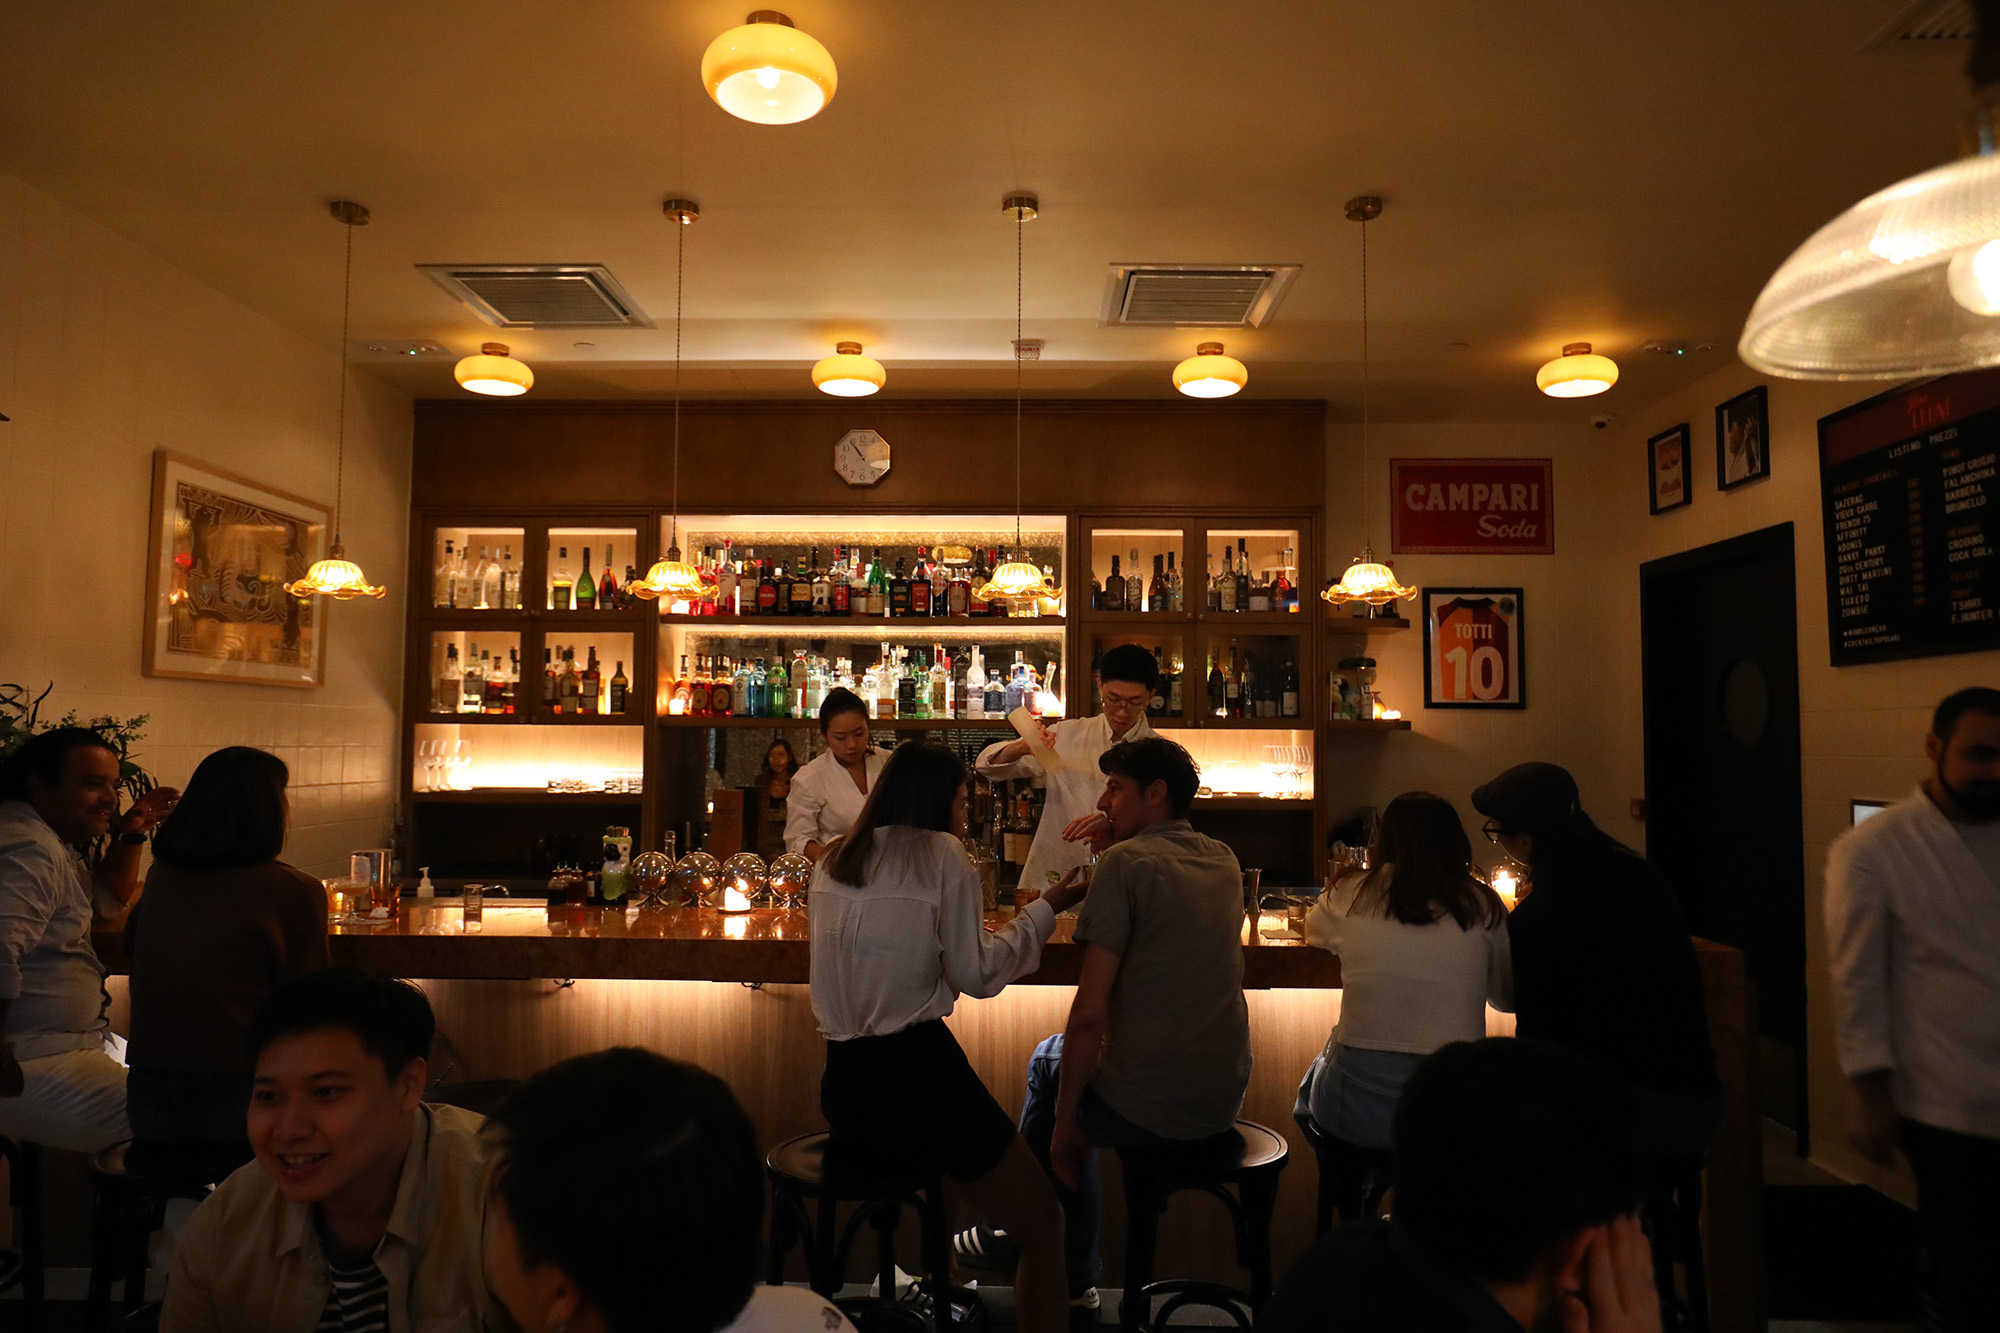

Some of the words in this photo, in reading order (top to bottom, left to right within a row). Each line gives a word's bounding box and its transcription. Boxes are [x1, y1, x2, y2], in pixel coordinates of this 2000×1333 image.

[1888, 440, 1922, 459] LISTINO
[1928, 427, 1958, 446] PREZZI
[1405, 483, 1539, 511] CAMPARI
[1834, 493, 1864, 510] SAZERAC
[1945, 494, 1987, 515] BRUNELLO
[1835, 508, 1855, 520] VIEUX
[1836, 517, 1861, 531] FRENCH
[1862, 513, 1872, 524] 75
[1477, 514, 1538, 538] Soda
[1836, 526, 1868, 542] AFFINITY
[1838, 539, 1863, 553] ADONIS
[1838, 550, 1860, 564] HANKY
[1864, 544, 1886, 558] PANKY
[1948, 550, 1970, 563] COCA
[1972, 546, 1993, 558] COLA
[1855, 556, 1884, 571] CENTURY
[1839, 573, 1858, 585] DIRTY
[1861, 565, 1893, 580] MARTINI
[1840, 585, 1853, 596] MAI
[1857, 582, 1869, 592] TAI
[1840, 593, 1871, 607] TUXEDO
[1841, 604, 1870, 618] ZOMBIE
[1455, 623, 1493, 639] TOTTI
[1445, 645, 1504, 700] 10
